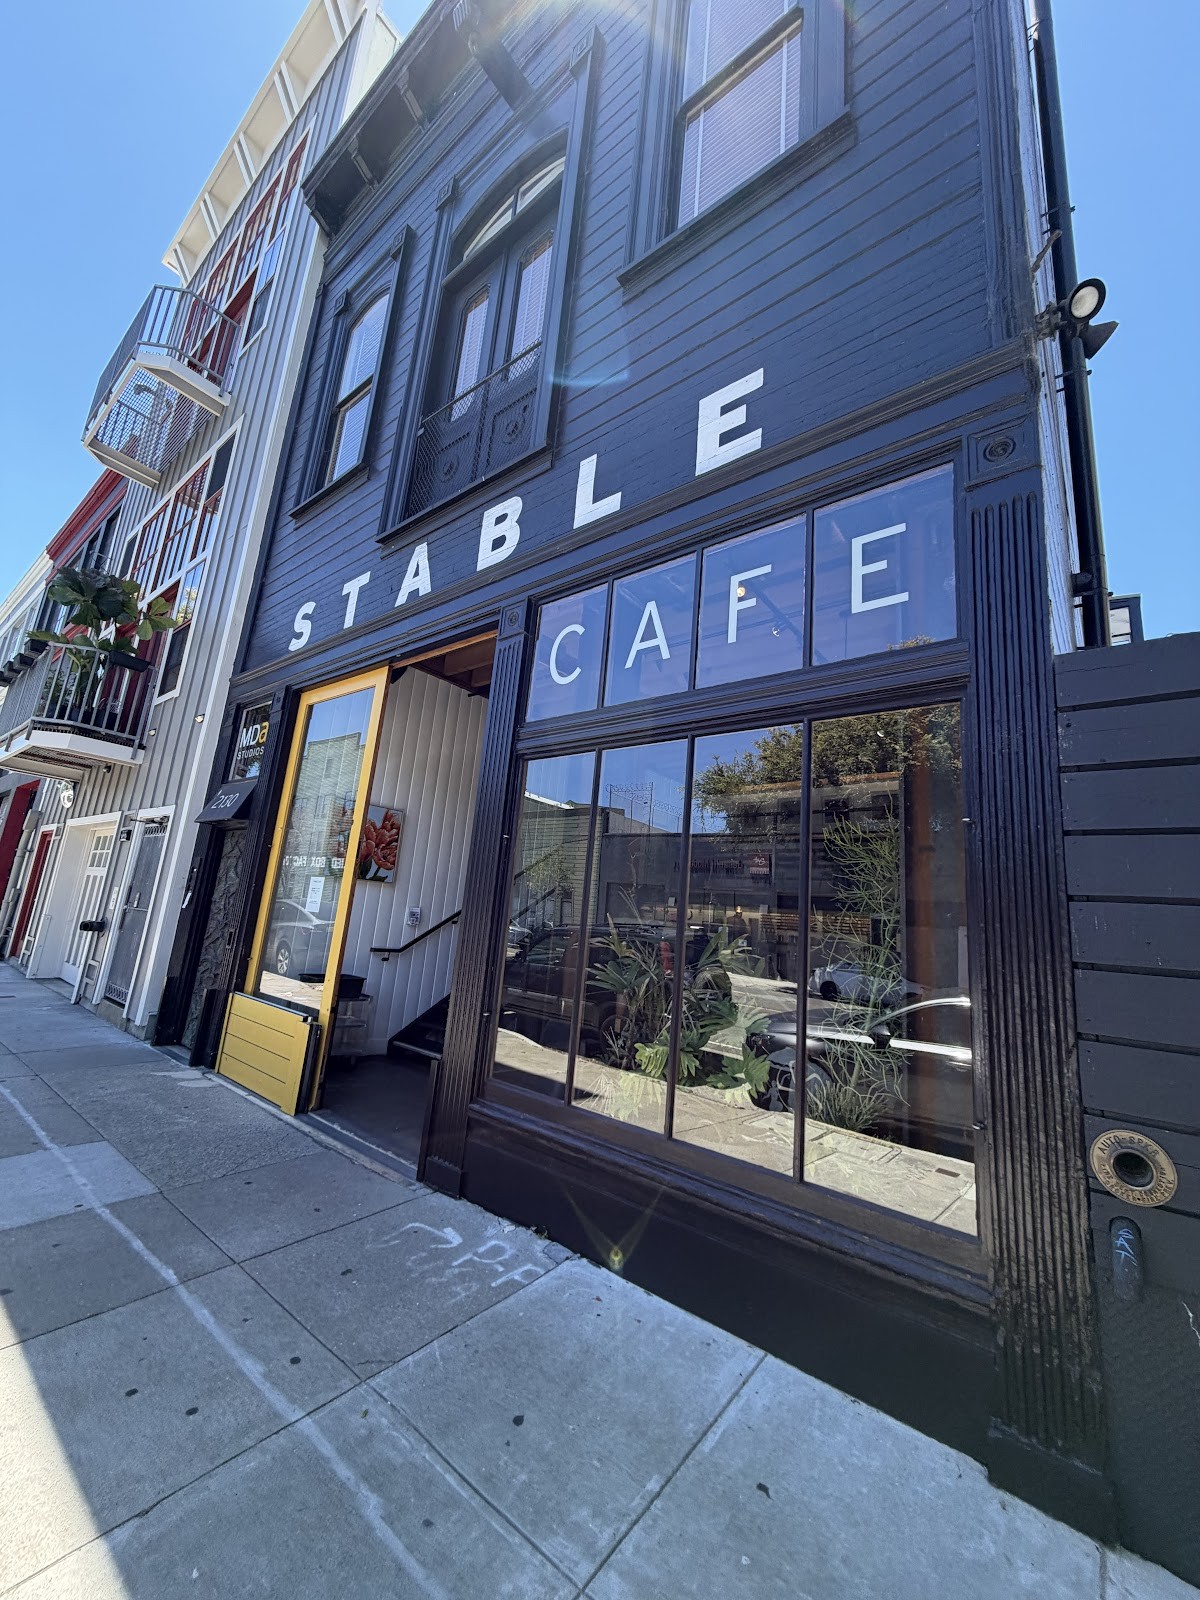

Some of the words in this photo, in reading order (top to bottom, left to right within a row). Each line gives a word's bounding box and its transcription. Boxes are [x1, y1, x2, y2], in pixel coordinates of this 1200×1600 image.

[288, 367, 764, 651] STABLE
[550, 523, 909, 685] CAFE
[236, 746, 265, 760] STUDIOS
